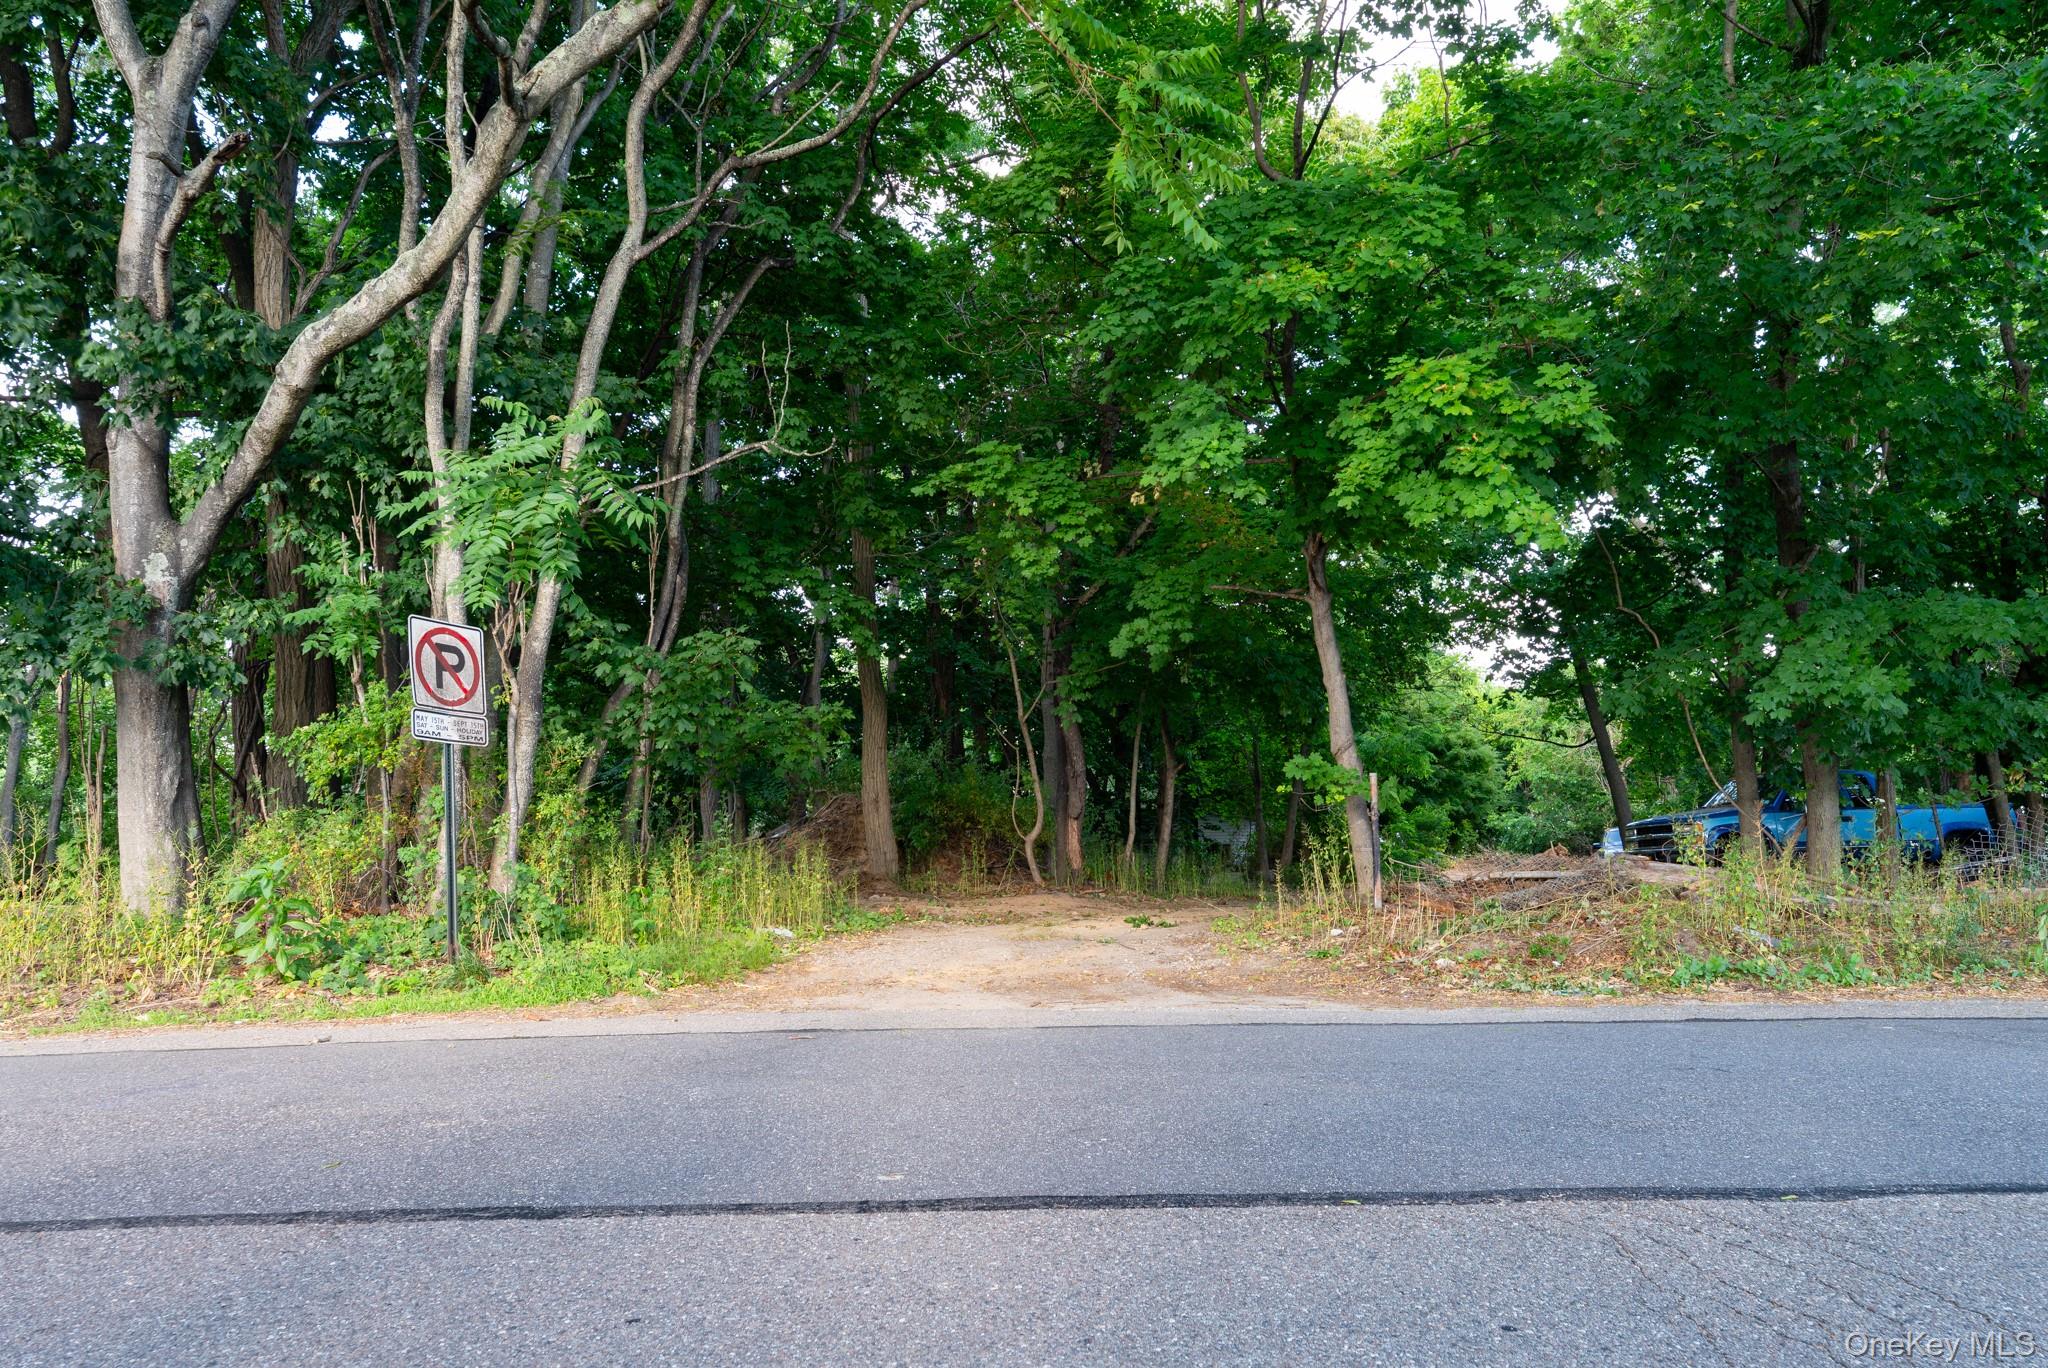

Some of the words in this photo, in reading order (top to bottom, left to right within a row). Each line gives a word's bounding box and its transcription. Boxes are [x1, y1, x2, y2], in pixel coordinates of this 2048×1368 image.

[434, 642, 465, 689] P
[416, 714, 428, 722] MAY
[453, 720, 467, 728] SEPT
[416, 729, 441, 737] 9AM
